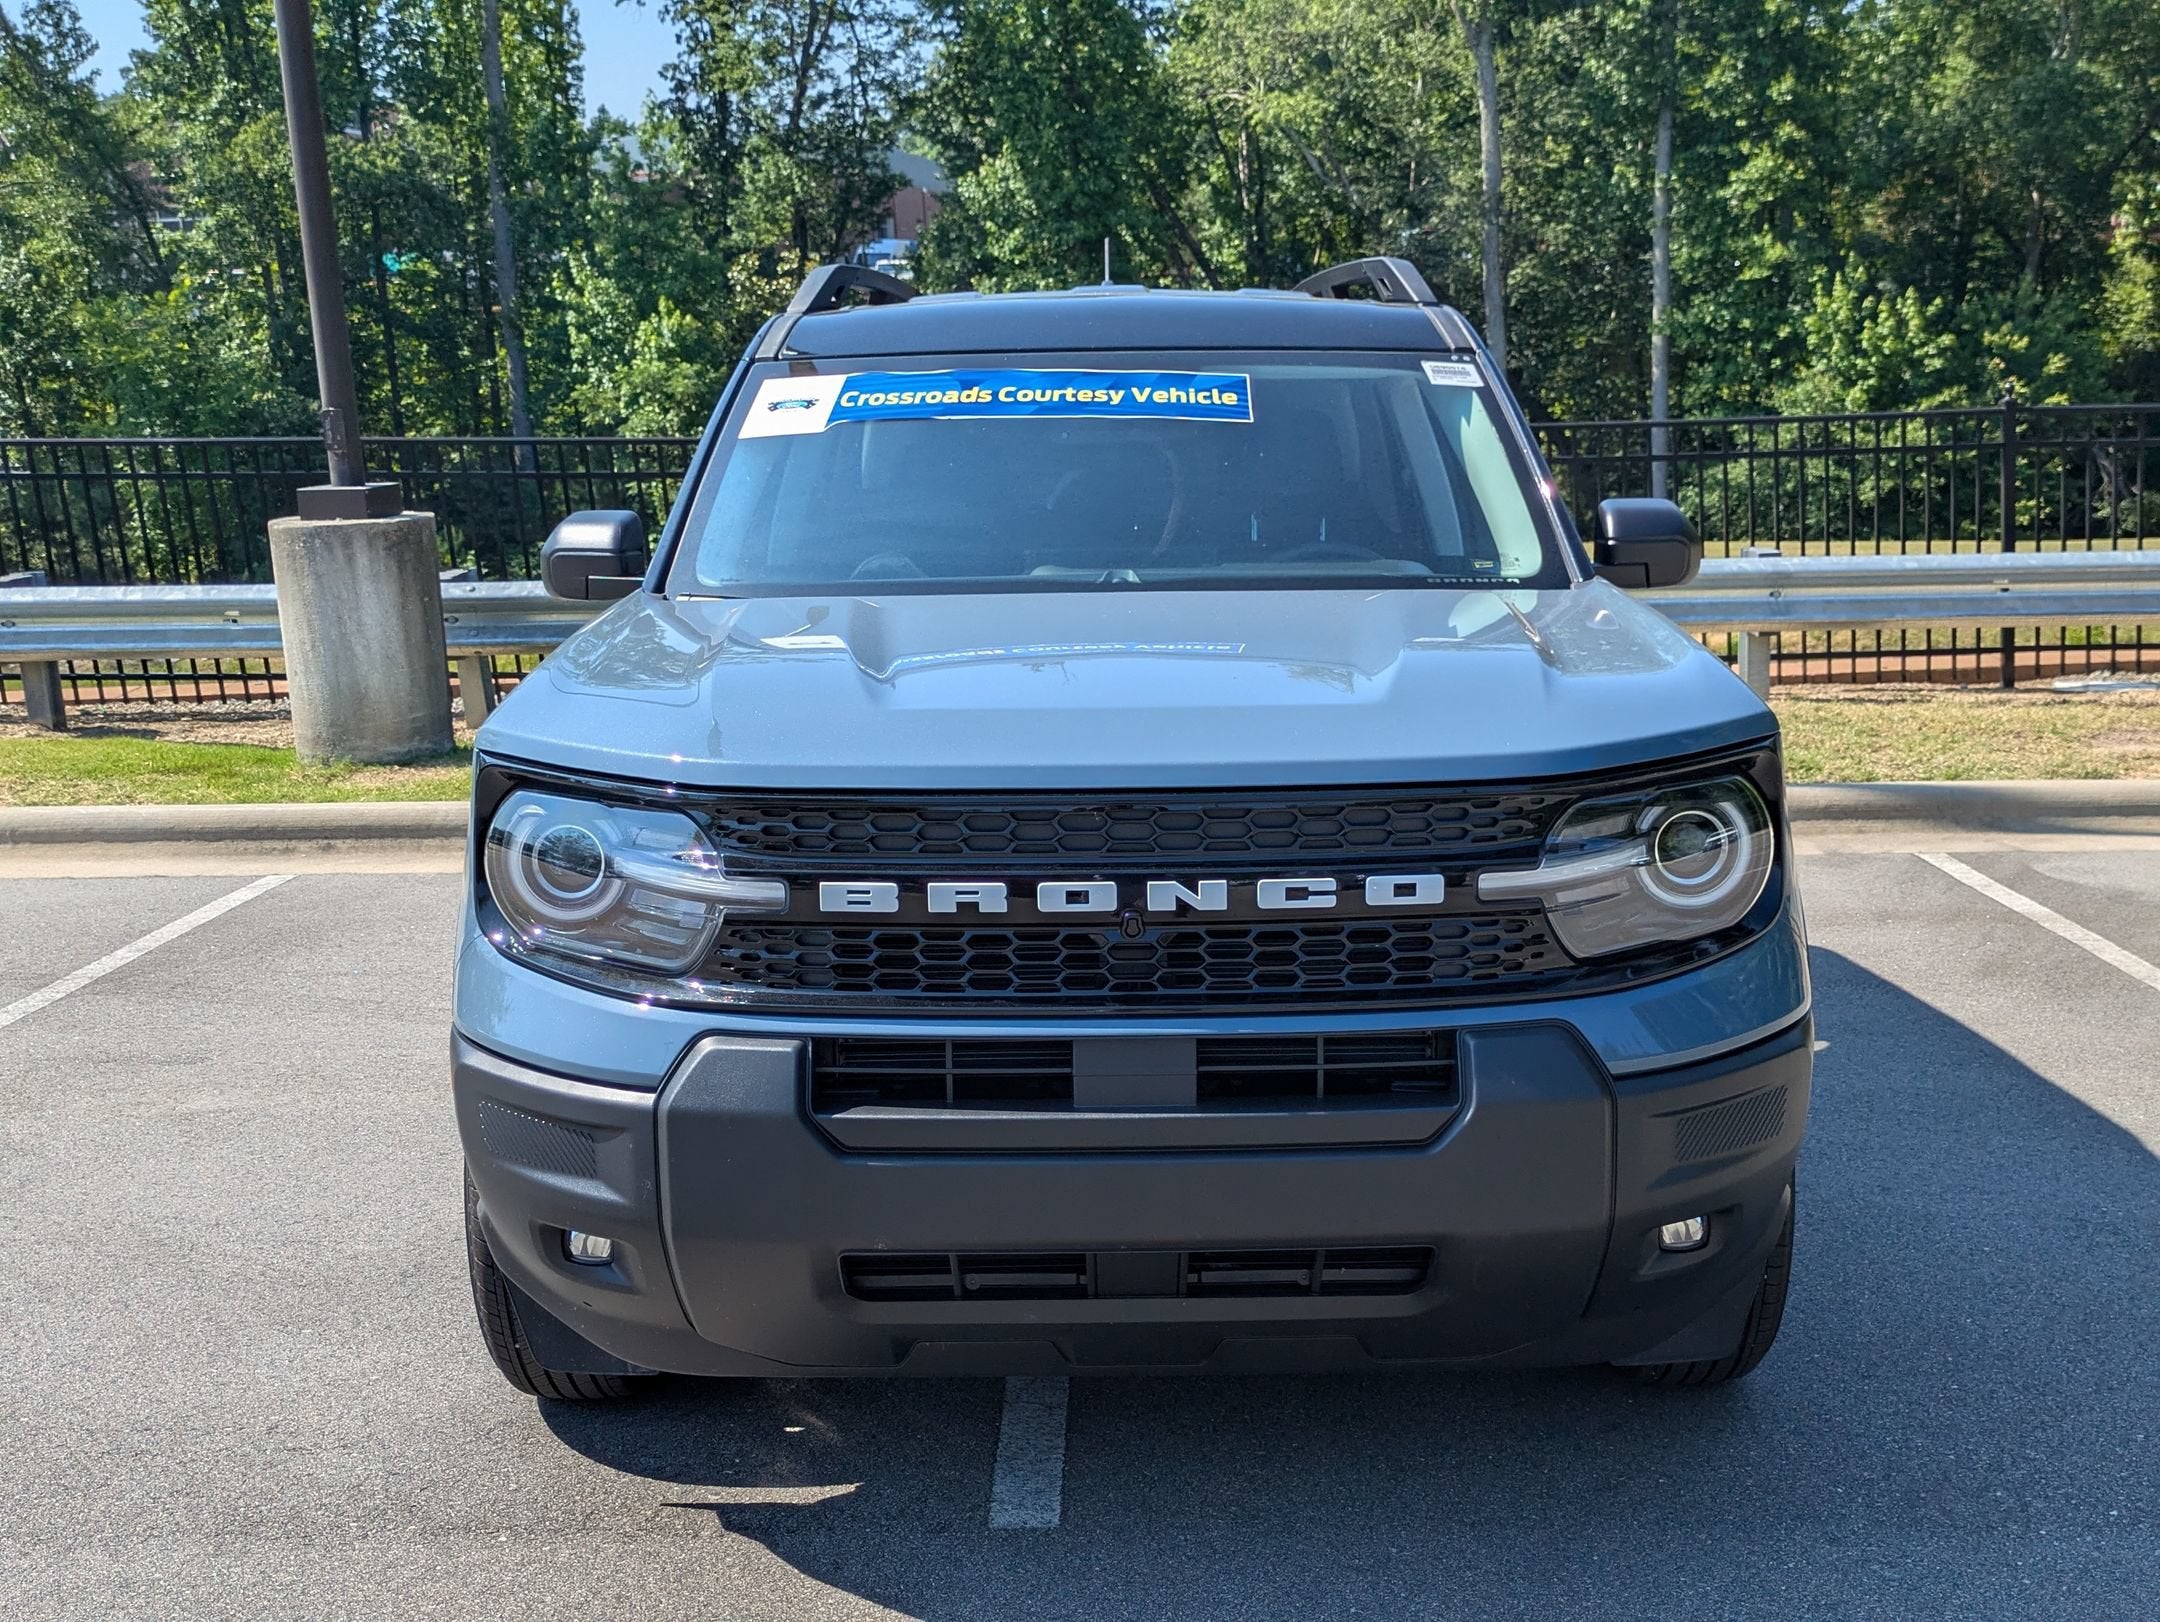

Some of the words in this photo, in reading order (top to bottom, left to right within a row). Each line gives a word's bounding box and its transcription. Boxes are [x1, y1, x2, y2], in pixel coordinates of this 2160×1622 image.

[840, 387, 993, 408] Crossroads
[998, 386, 1123, 406] Courtesy
[1131, 386, 1239, 405] Vehicle
[818, 873, 1446, 915] BRONCO
